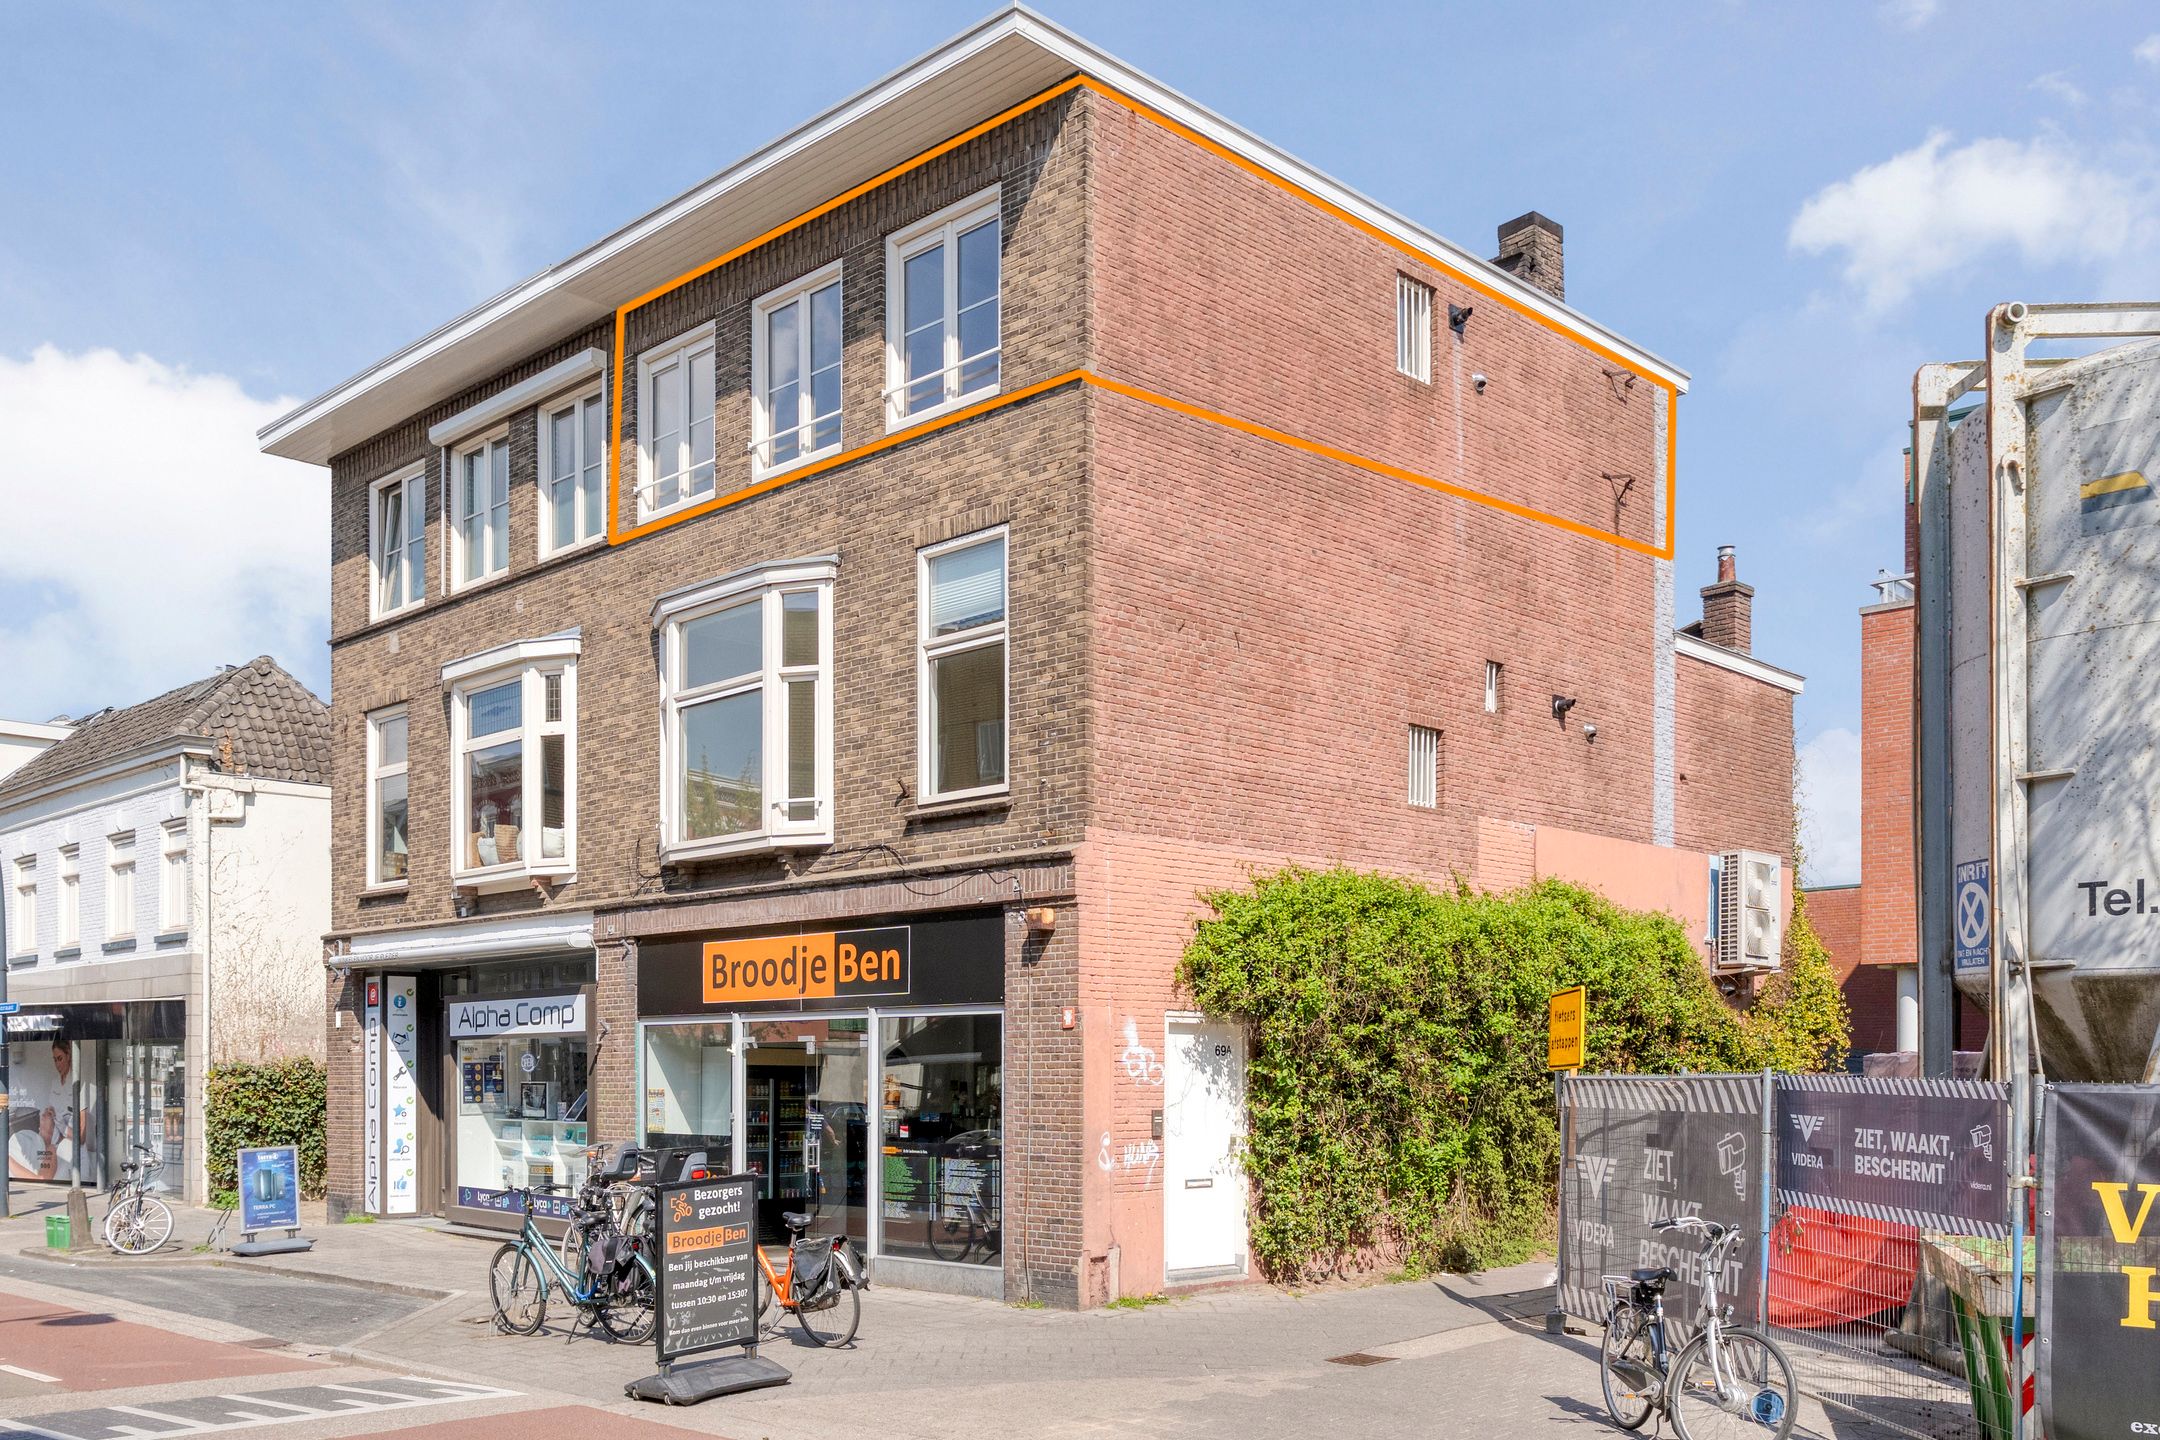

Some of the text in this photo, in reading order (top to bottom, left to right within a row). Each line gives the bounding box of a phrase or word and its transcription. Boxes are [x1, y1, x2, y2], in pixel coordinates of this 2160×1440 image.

[2077, 879, 2159, 917] Tel.
[712, 943, 901, 994] Broodje Ben
[458, 1002, 575, 1033] Alpha Comp
[1215, 1045, 1231, 1056] 69A
[367, 1017, 378, 1211] Alpha Comp
[1854, 1127, 1955, 1161] ZIET, WAAKT,
[1643, 1148, 1678, 1190] ZIET,
[1791, 1152, 1824, 1169] VIDERA
[1854, 1154, 1946, 1185] BESCHERMT
[694, 1187, 743, 1201] Bezorgers
[698, 1201, 741, 1220] gezocht!
[673, 1229, 746, 1248] Broodje Ben
[1573, 1218, 1615, 1249] VIDERA
[668, 1263, 684, 1271] Ben
[684, 1260, 693, 1272] jij
[694, 1255, 735, 1268] beschikbaar
[1638, 1239, 1744, 1297] BESCHEMT
[672, 1272, 745, 1290] maandag t/m vrijdag
[671, 1300, 696, 1310] tussen
[697, 1295, 717, 1306] 10:30
[727, 1289, 748, 1300] 15:30?
[2130, 1421, 2160, 1435] ex
